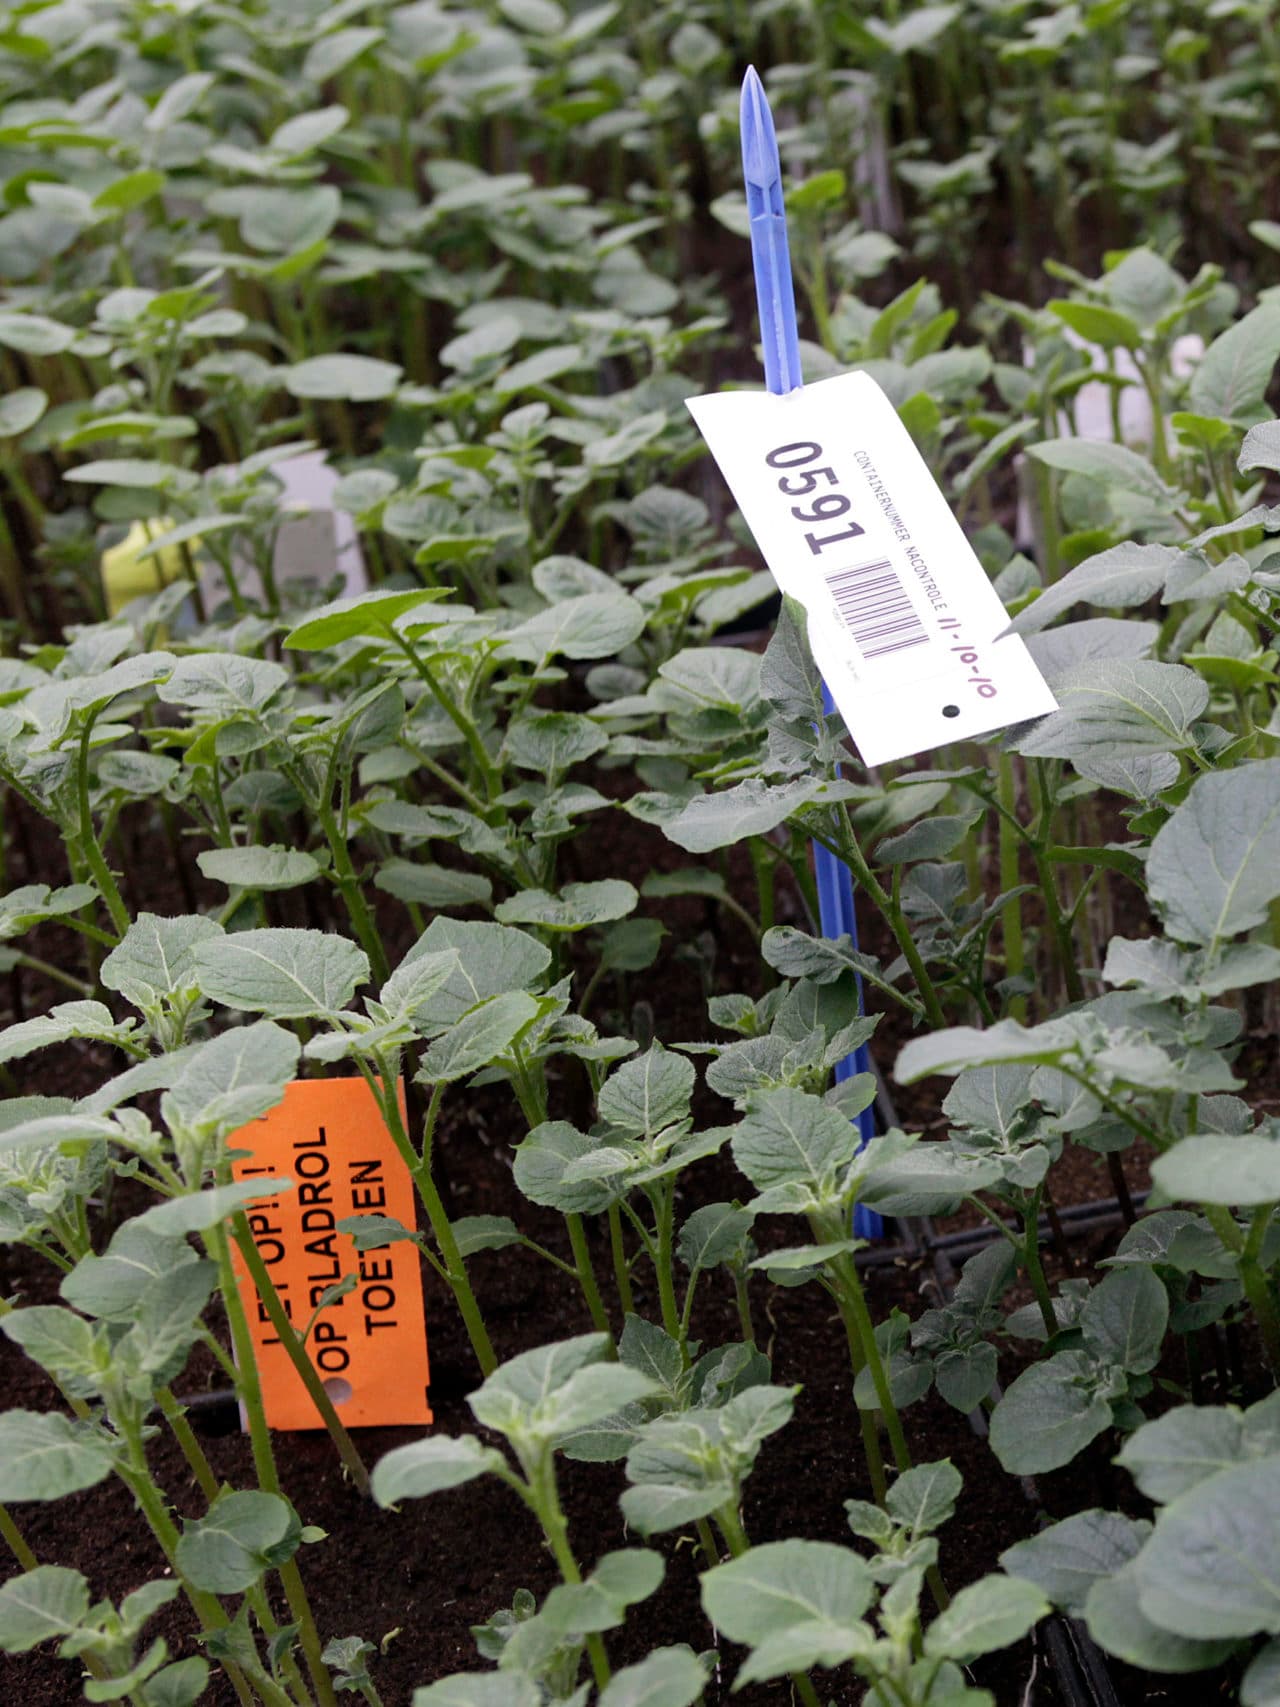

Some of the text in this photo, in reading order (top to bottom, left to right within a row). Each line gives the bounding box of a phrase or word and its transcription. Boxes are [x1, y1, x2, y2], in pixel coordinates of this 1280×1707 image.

[765, 441, 866, 556] 0591
[853, 450, 948, 611] CONTAINERNUMMER NACONTROLE
[293, 1127, 350, 1373] OP BLADROL
[349, 1160, 397, 1336] TOEEN
